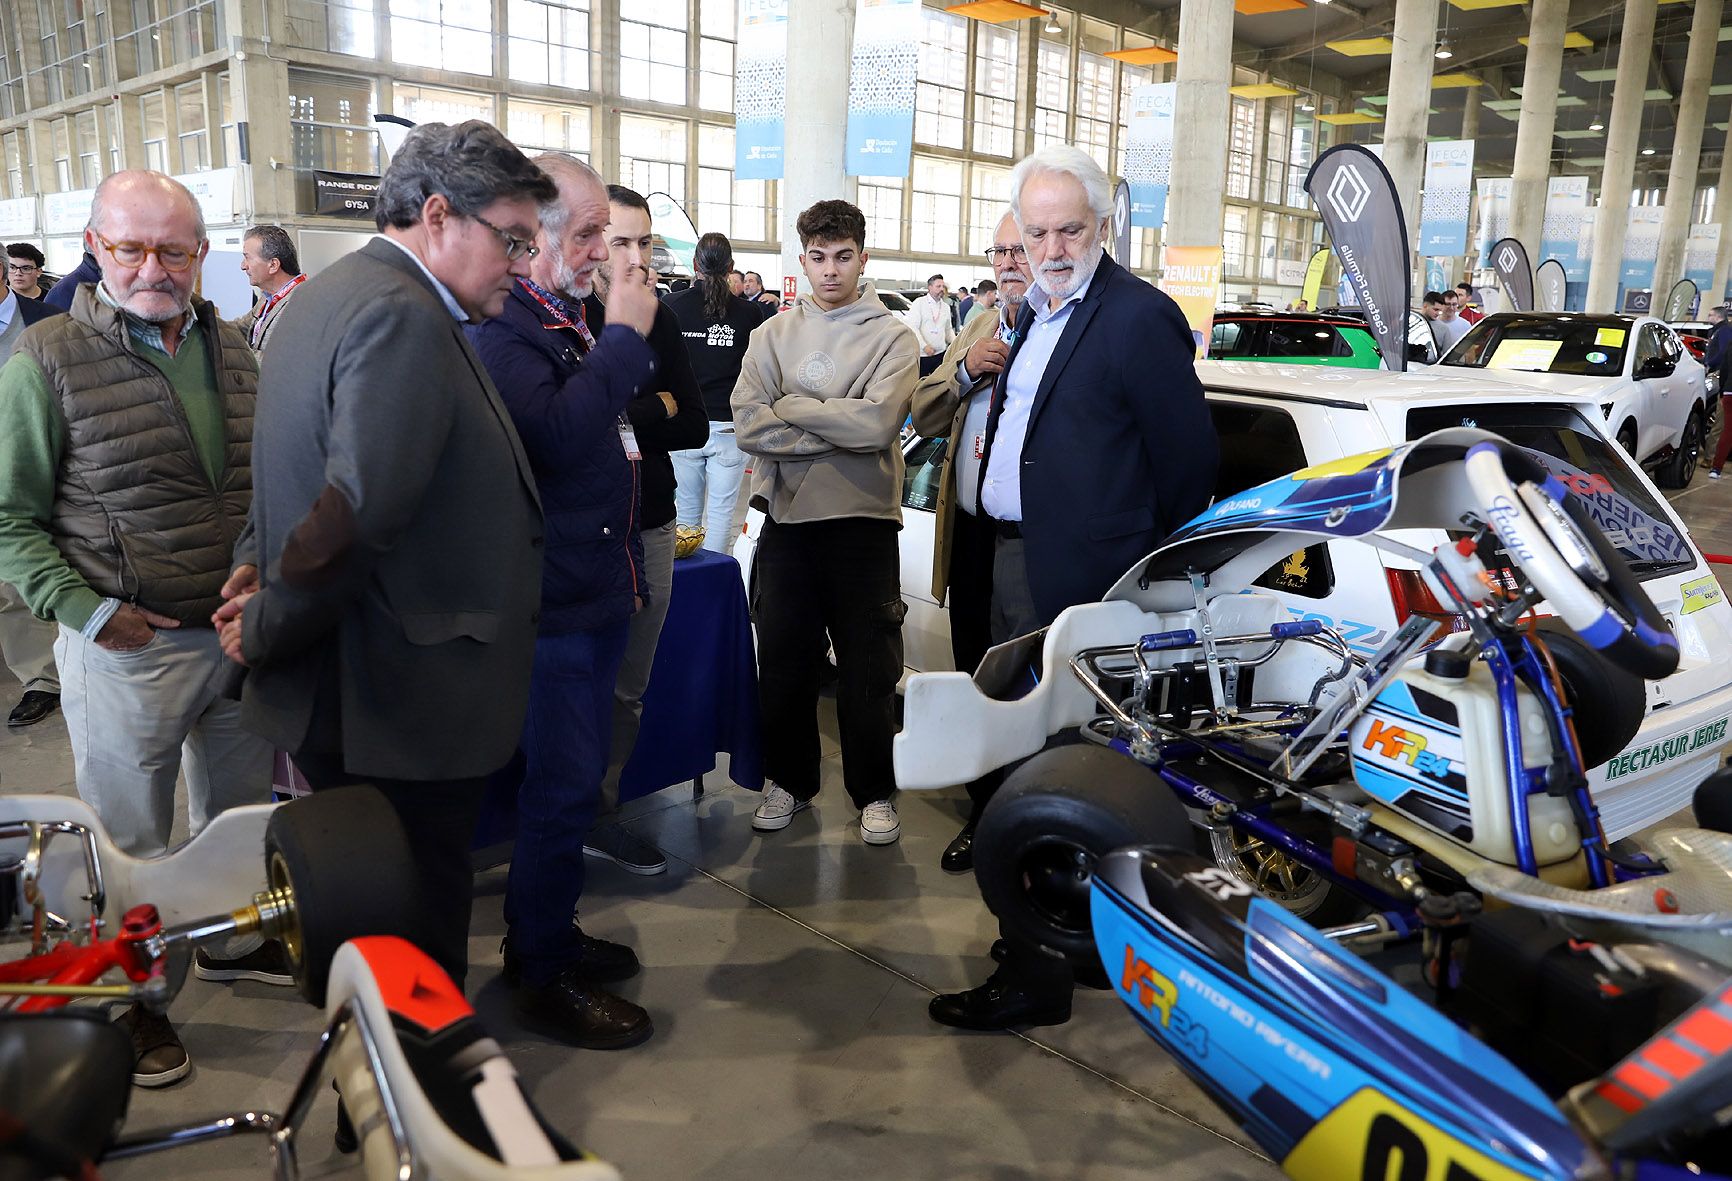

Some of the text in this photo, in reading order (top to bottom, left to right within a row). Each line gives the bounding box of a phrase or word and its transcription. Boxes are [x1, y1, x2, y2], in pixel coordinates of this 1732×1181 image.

[1136, 96, 1172, 108] IFECA
[1431, 150, 1469, 160] IFECA
[317, 180, 356, 189] RANGE
[344, 200, 370, 210] GYSA
[1164, 264, 1210, 282] RENAULT
[1605, 716, 1729, 781] RECTASUR JEREZ
